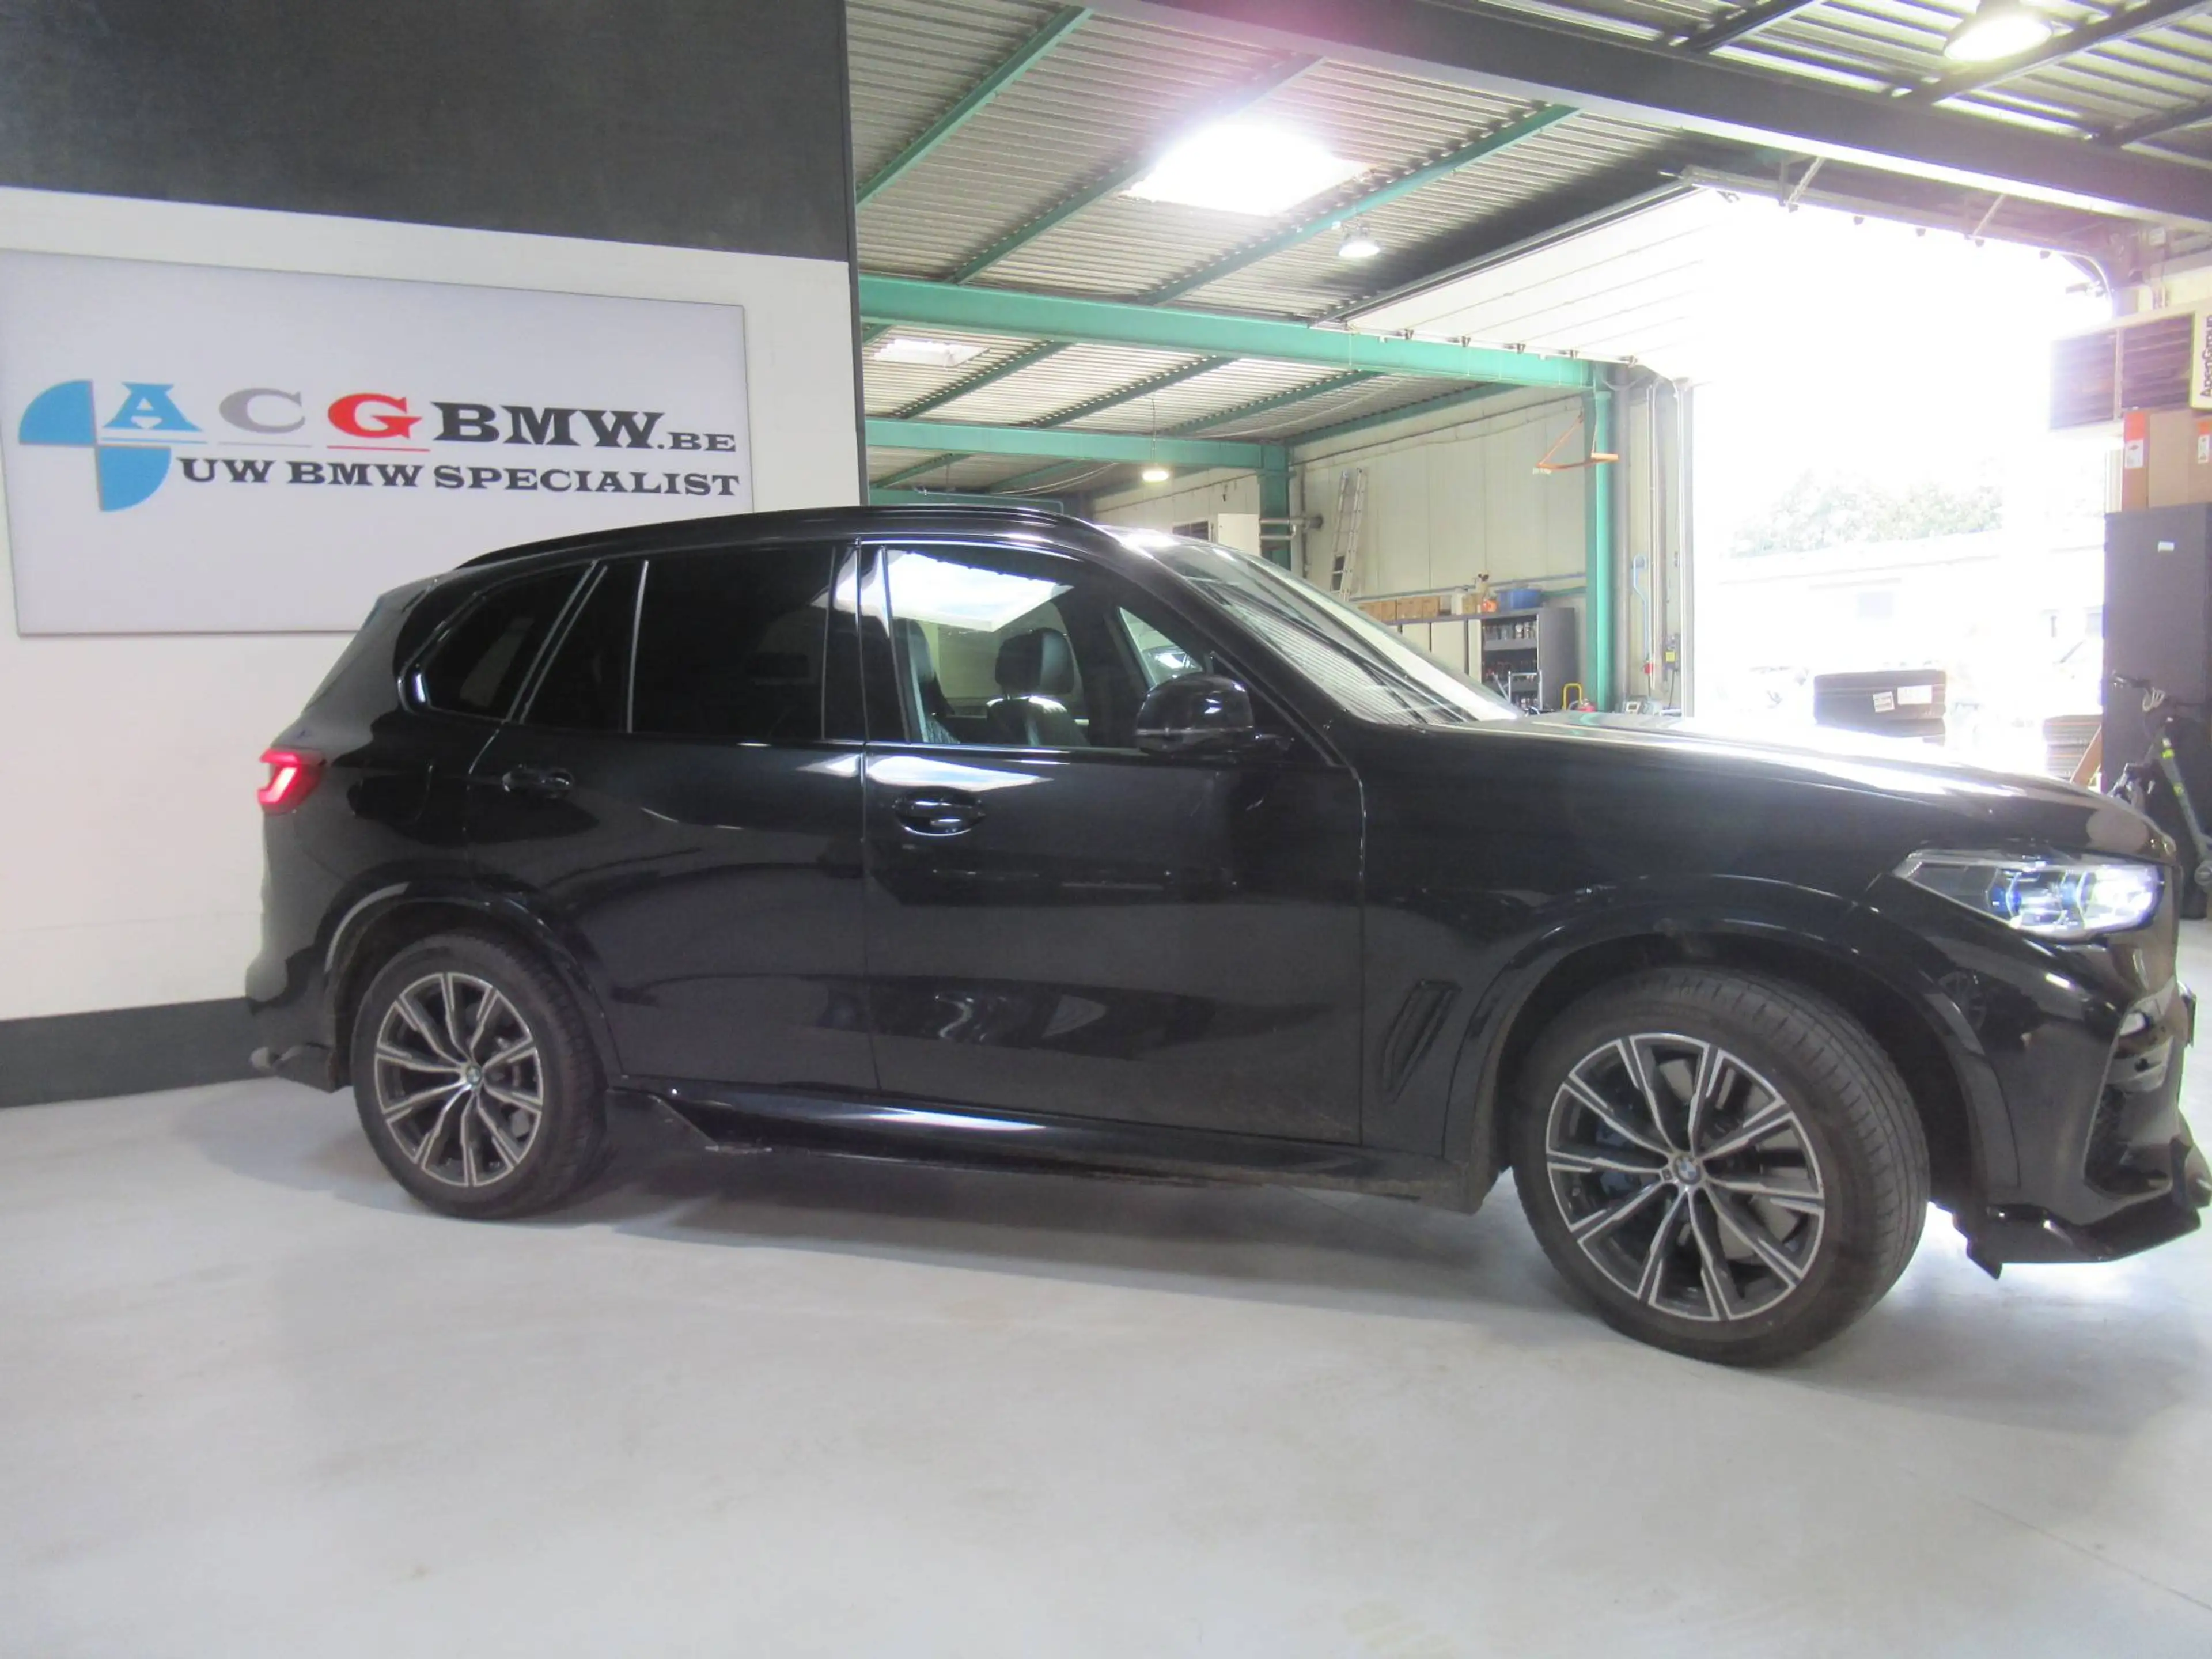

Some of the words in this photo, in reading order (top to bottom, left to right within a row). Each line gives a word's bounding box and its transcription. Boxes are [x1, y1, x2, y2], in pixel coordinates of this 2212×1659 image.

[176, 457, 276, 483] UW
[286, 460, 425, 487] BMW
[433, 464, 740, 497] SPECIALIST
